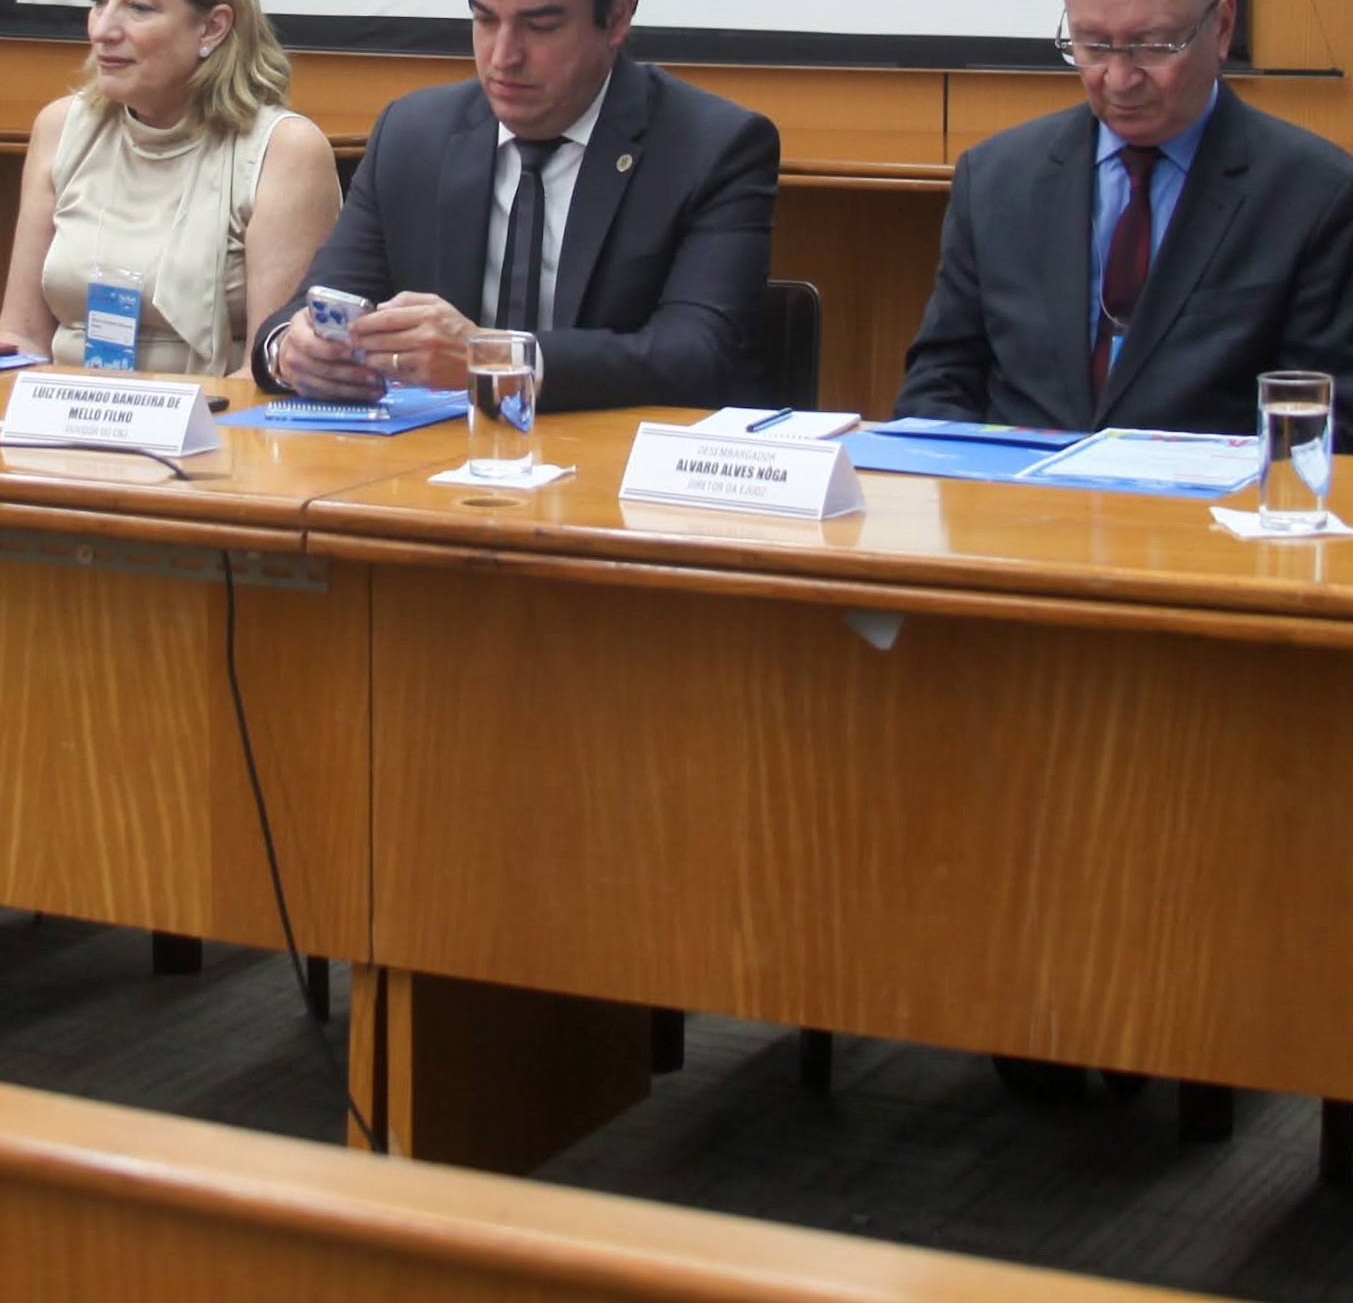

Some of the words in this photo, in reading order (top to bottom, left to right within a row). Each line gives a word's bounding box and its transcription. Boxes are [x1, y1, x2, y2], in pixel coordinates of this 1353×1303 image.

[32, 386, 56, 399] LUIZ
[56, 388, 111, 404] FERNANDO
[111, 393, 165, 408] BANDEIRA
[166, 396, 181, 409] DE
[68, 407, 102, 420] MELLO
[103, 409, 134, 423] FILHO
[697, 444, 777, 462] DESEMBARGADOR
[676, 458, 719, 475] ALVARO
[720, 463, 754, 479] ALVES
[687, 479, 723, 493] DIRETOR
